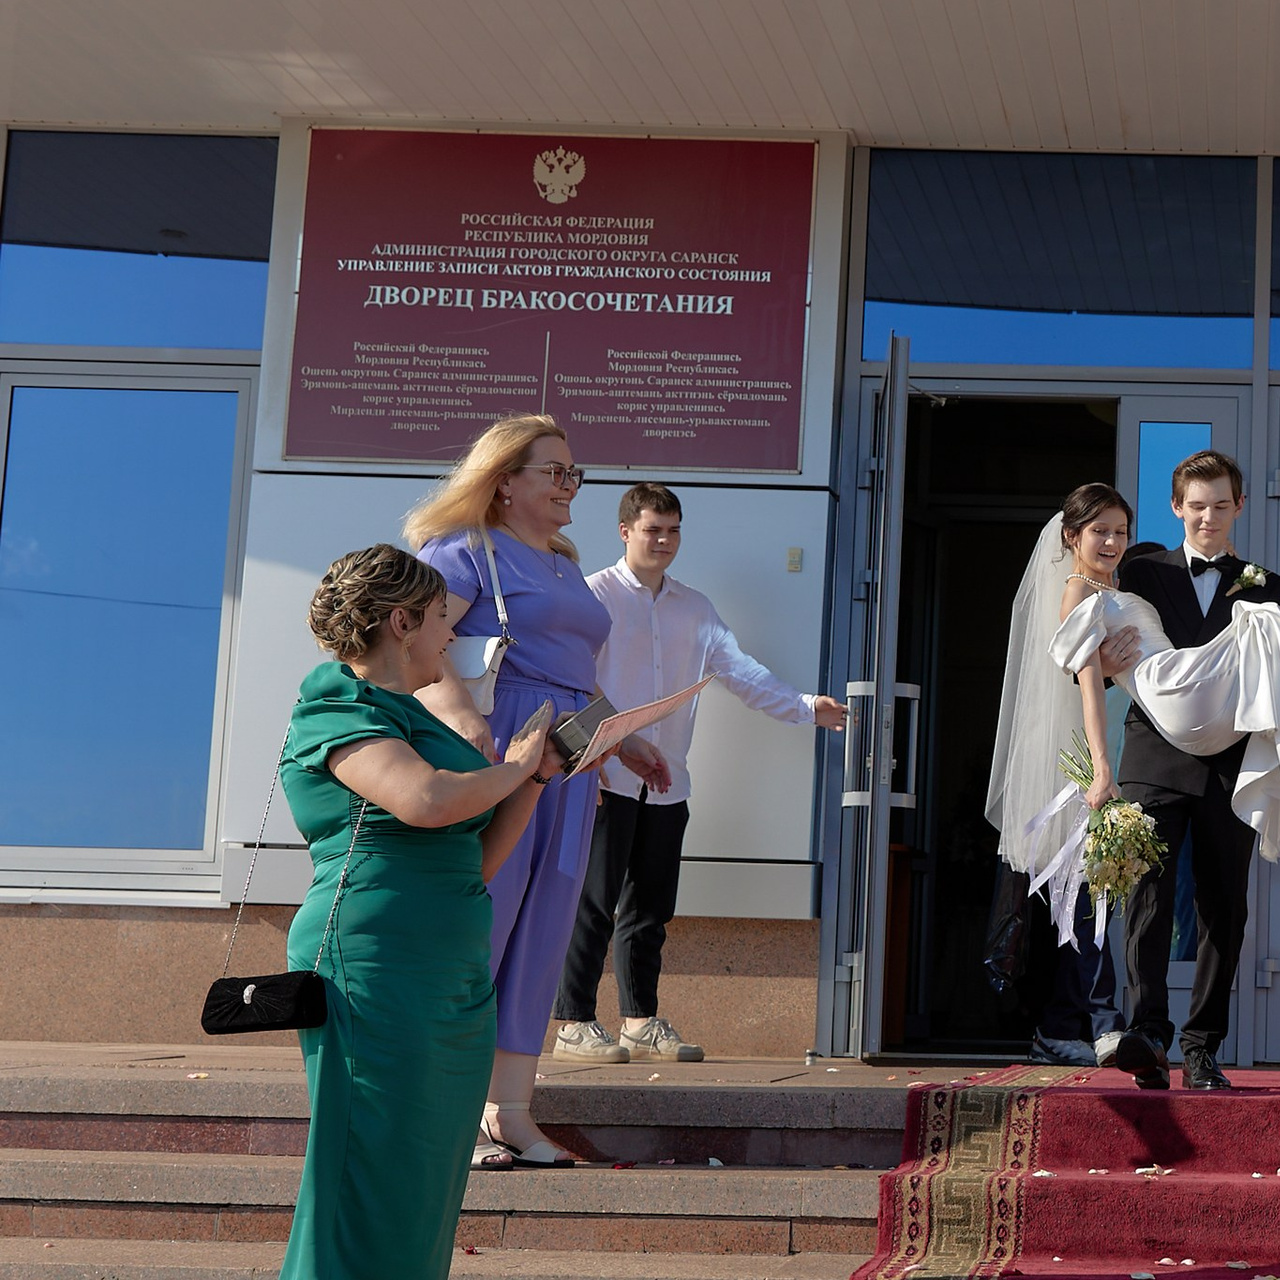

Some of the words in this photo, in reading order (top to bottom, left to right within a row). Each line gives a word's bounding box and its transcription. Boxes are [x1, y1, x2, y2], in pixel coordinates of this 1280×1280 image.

[460, 213, 562, 227] РОССИЙСКАЯ
[566, 217, 654, 230] ФЕДЕРАЦИЯ
[465, 230, 563, 244] РЕСПУБЛИКА
[567, 233, 649, 245] МОРДОВИЯ
[371, 244, 506, 259] АДМИНИСТРАЦИЯ
[510, 248, 607, 261] ГОРОДСКОГО
[611, 251, 667, 263] ОКРУГА
[671, 252, 739, 264] САРАНСК
[337, 259, 435, 273] УПРАВЛЕНИЕ
[438, 262, 498, 275] ЗАПИСИ
[502, 264, 551, 277] АКТОВ
[555, 265, 675, 279] ГРАЖДАНСКОГО
[678, 269, 771, 282] СОСТОЯНИЯ
[363, 285, 474, 311] ДВОРЕЦ
[481, 289, 734, 315] БРАКОСОЧЕТАНИЯ
[418, 344, 490, 357] Федерациясь
[607, 349, 668, 361] Российской
[671, 350, 742, 363] Федерациясь
[354, 354, 409, 367] Мордовия
[412, 356, 486, 369] Республикась
[608, 362, 663, 374] Мордовия
[665, 363, 739, 376] Республикась
[341, 369, 390, 380] округонь
[393, 368, 440, 381] Саранск
[442, 372, 538, 384] администрациясь
[595, 376, 644, 387] округонь
[647, 375, 693, 388] Саранск
[696, 378, 792, 390] администрациясь
[396, 397, 473, 408] управлениясь
[650, 404, 726, 415] управлениясь
